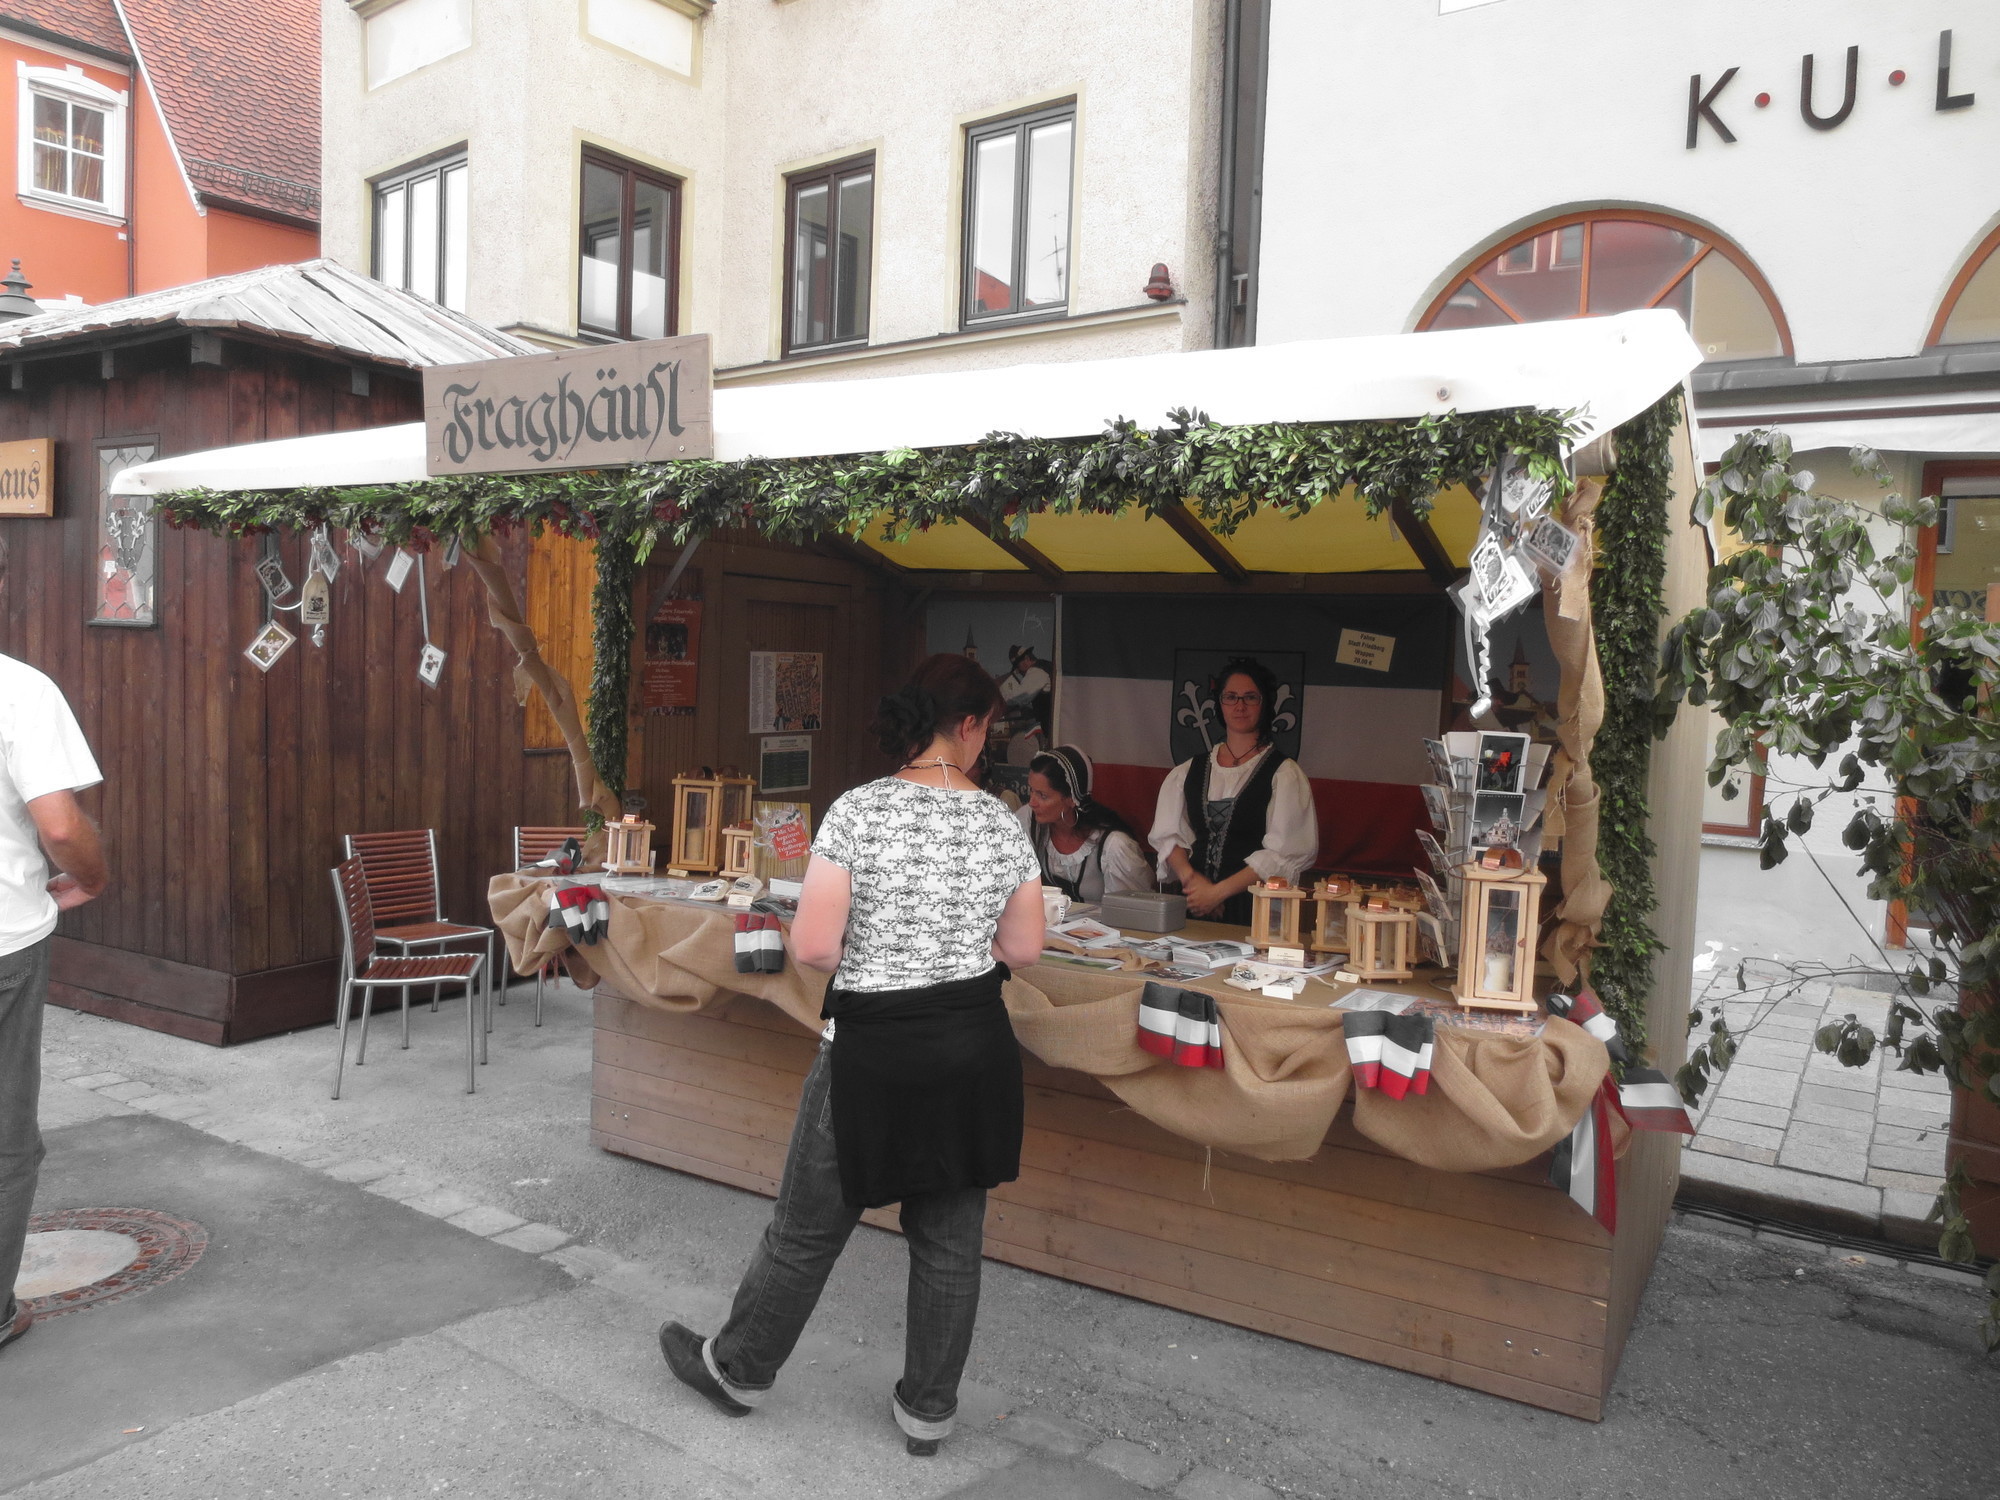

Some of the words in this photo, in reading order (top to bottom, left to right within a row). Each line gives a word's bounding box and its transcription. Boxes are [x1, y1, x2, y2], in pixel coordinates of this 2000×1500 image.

[1361, 642, 1385, 652] Friedberg
[1355, 649, 1374, 658] Wappen
[778, 841, 806, 853] Friedberger
